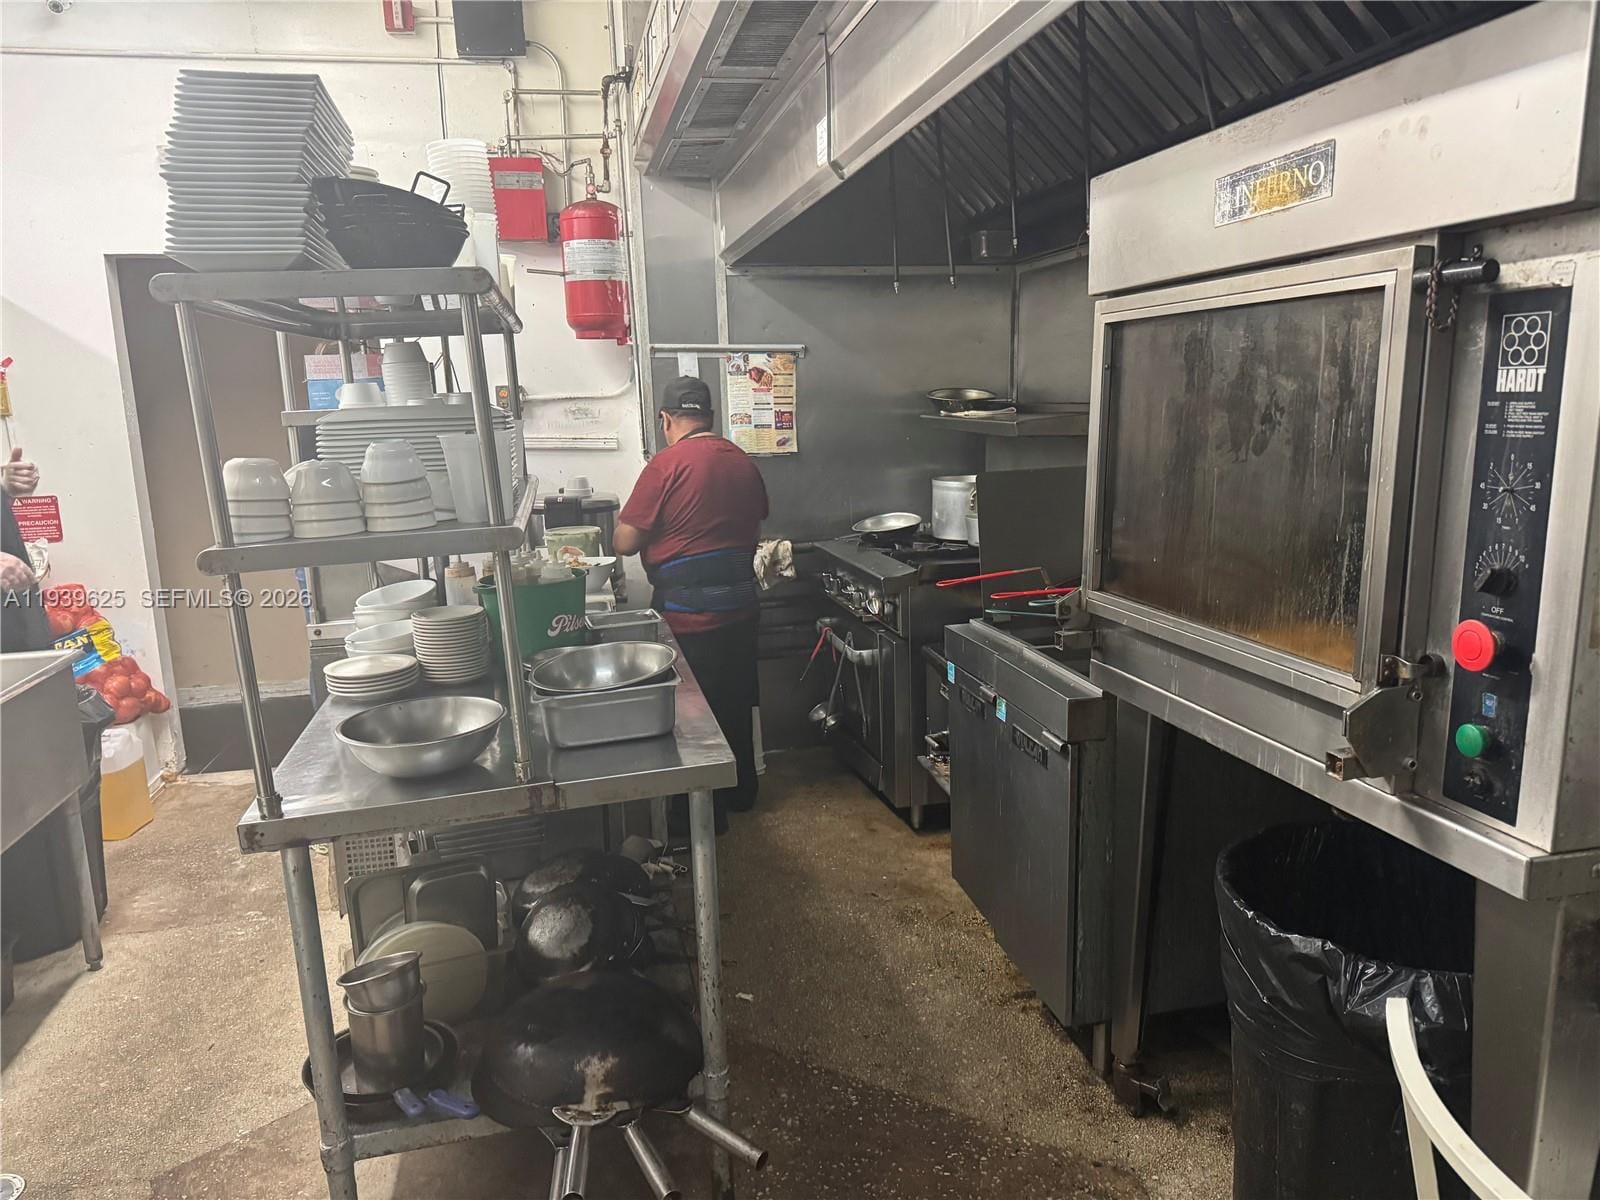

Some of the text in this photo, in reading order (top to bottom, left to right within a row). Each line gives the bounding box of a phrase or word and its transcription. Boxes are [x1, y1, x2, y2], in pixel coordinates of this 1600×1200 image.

[1235, 160, 1325, 208] INFERNO
[1496, 368, 1547, 393] HARDT
[1491, 606, 1505, 615] OFF
